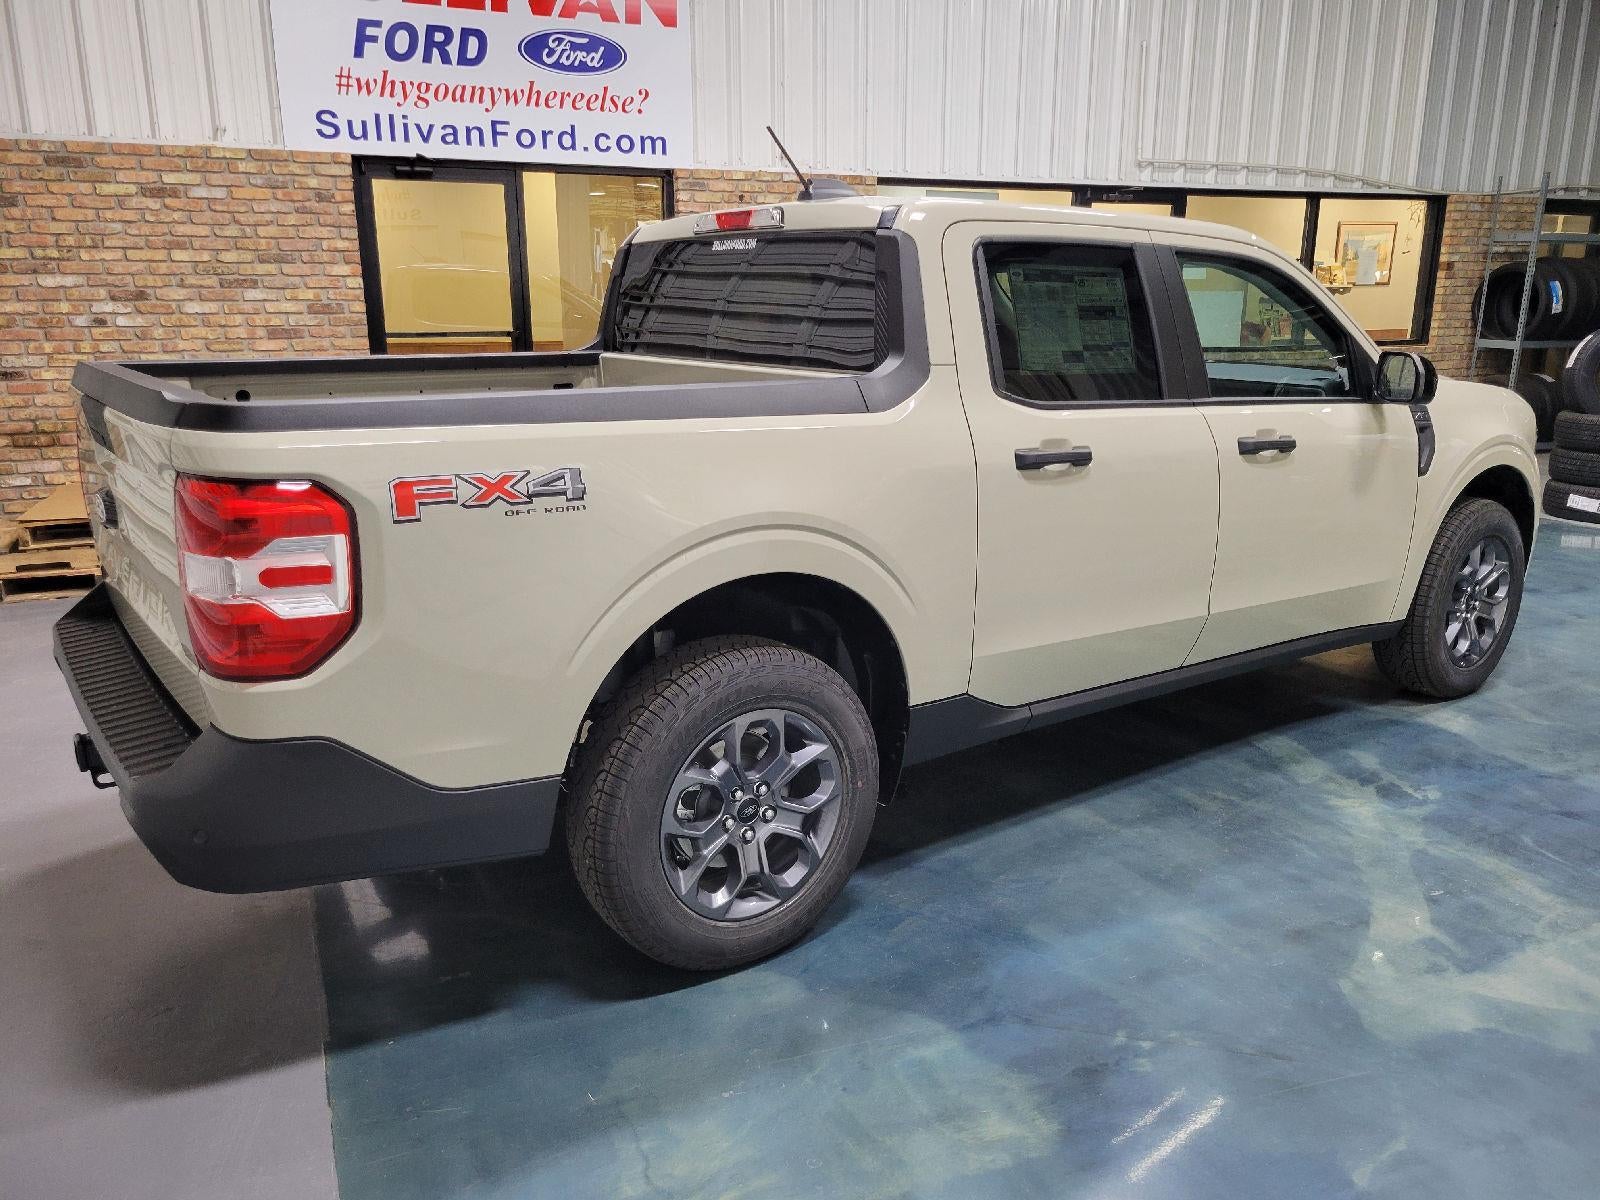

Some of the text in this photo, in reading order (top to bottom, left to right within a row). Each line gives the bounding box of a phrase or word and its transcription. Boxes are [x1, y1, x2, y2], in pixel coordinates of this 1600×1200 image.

[353, 18, 488, 67] FORD
[541, 31, 604, 70] Ford
[335, 66, 650, 115] #whygoanywhereelse?
[315, 109, 668, 156] SullivanFord.com
[388, 467, 586, 524] FX4
[504, 505, 587, 517] OFF ROAD
